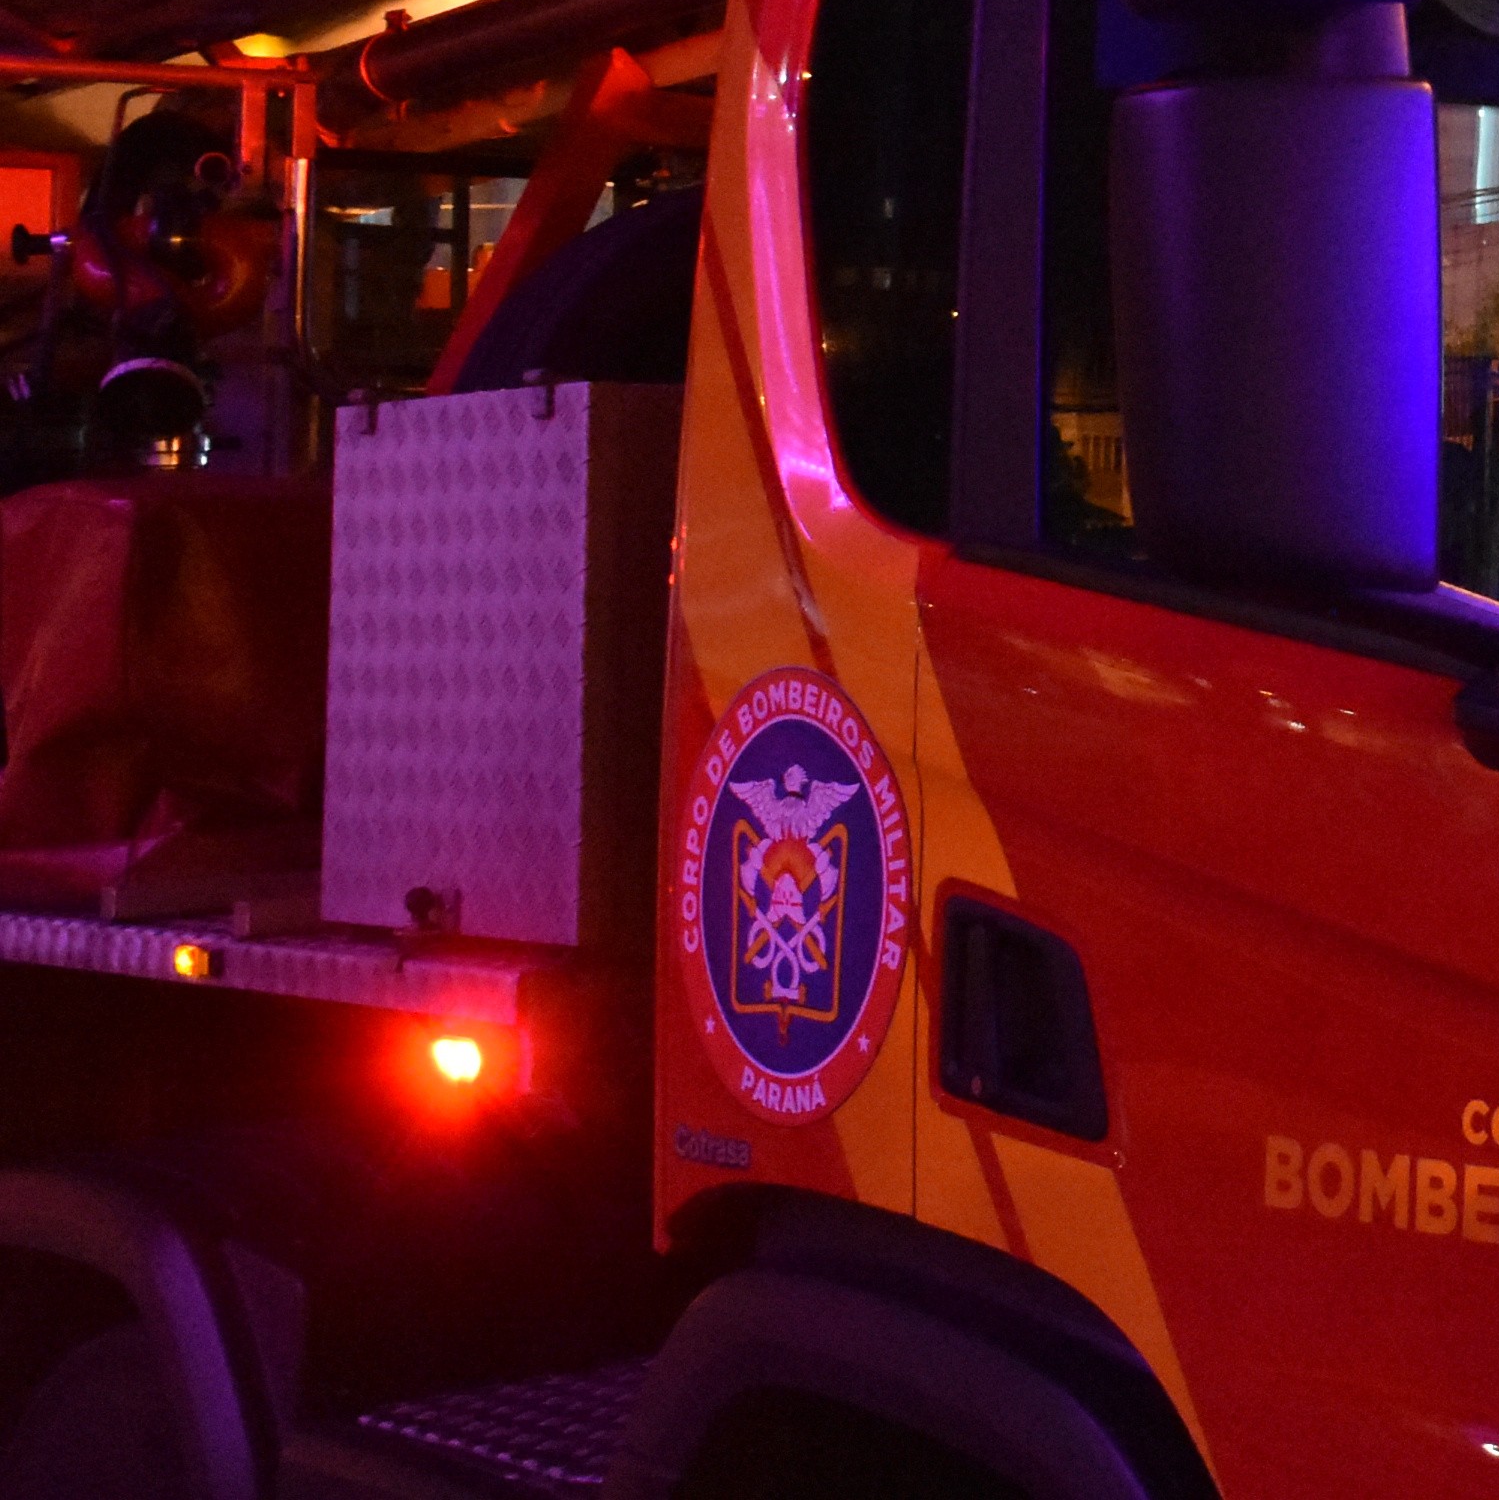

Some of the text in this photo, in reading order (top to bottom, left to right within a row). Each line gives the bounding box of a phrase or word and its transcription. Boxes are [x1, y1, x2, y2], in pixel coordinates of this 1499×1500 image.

[682, 680, 907, 970] CORPO DE BOMBEIROS MILITAR
[741, 1066, 826, 1115] PARANÁ
